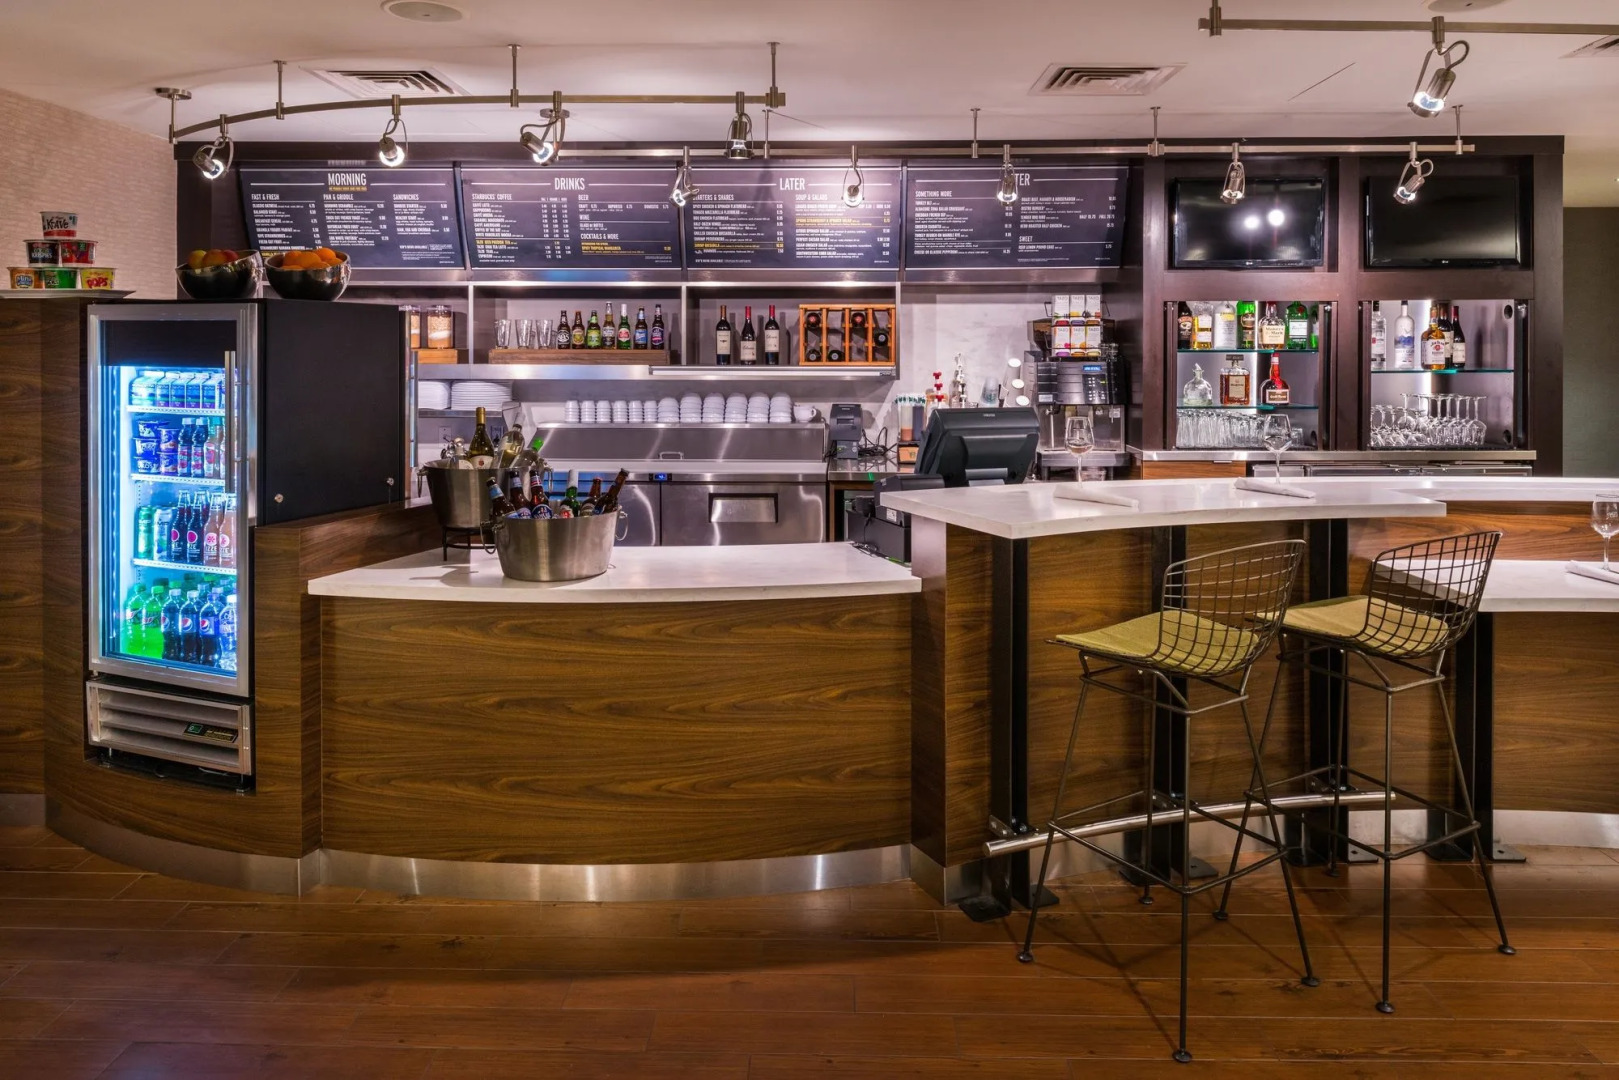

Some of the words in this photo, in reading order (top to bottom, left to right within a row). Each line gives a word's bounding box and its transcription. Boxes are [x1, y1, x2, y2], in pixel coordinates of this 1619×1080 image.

[328, 172, 366, 186] MORNING
[554, 178, 585, 190] DRINKS
[780, 178, 805, 190] LATER
